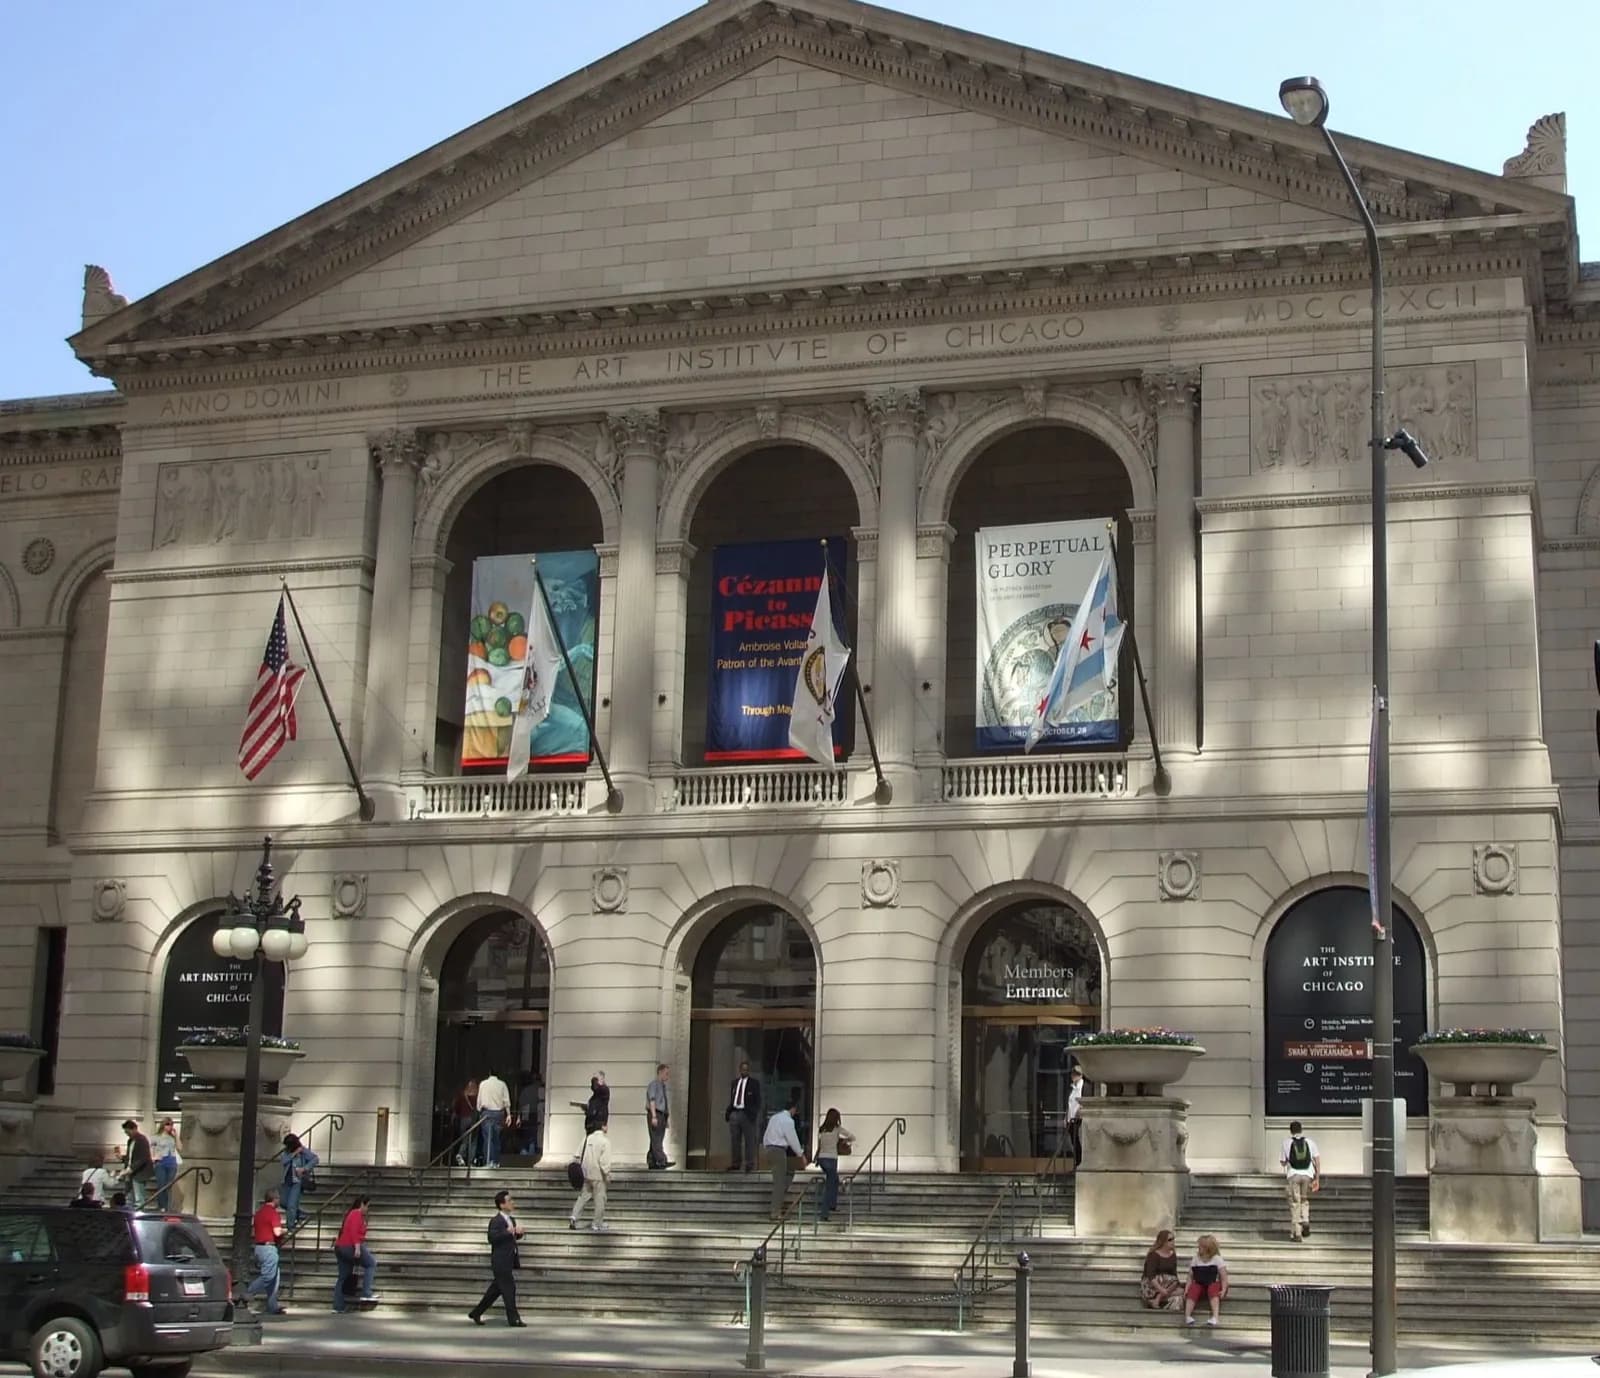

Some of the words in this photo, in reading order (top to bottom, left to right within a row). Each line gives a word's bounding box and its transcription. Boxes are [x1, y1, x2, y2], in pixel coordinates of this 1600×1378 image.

[1245, 285, 1477, 323] MDCCXCII
[479, 366, 532, 389] THE
[575, 356, 631, 380] ART
[667, 338, 828, 373] INSTITVTE
[867, 331, 908, 354] OF
[945, 316, 1085, 348] CHICAGO
[160, 392, 231, 417] ANNO
[244, 381, 341, 409] DOMINI
[988, 536, 1105, 559] PERPETUAL
[988, 560, 1056, 579] GLORY
[718, 573, 837, 597] Cézann
[767, 599, 788, 612] to
[723, 609, 813, 632] Picass
[738, 640, 781, 653] Ambroise
[783, 638, 809, 651] Vollar
[716, 658, 745, 671] Patron
[748, 658, 757, 668] of
[760, 657, 775, 668] the
[741, 704, 775, 717] Through
[1320, 946, 1336, 954] THE
[1303, 957, 1329, 967] ART
[1333, 955, 1402, 967] INSTITE
[180, 972, 200, 982] ART
[1003, 962, 1074, 979] Members
[1006, 983, 1073, 999] Entrance
[1302, 981, 1364, 992] CHICAGO
